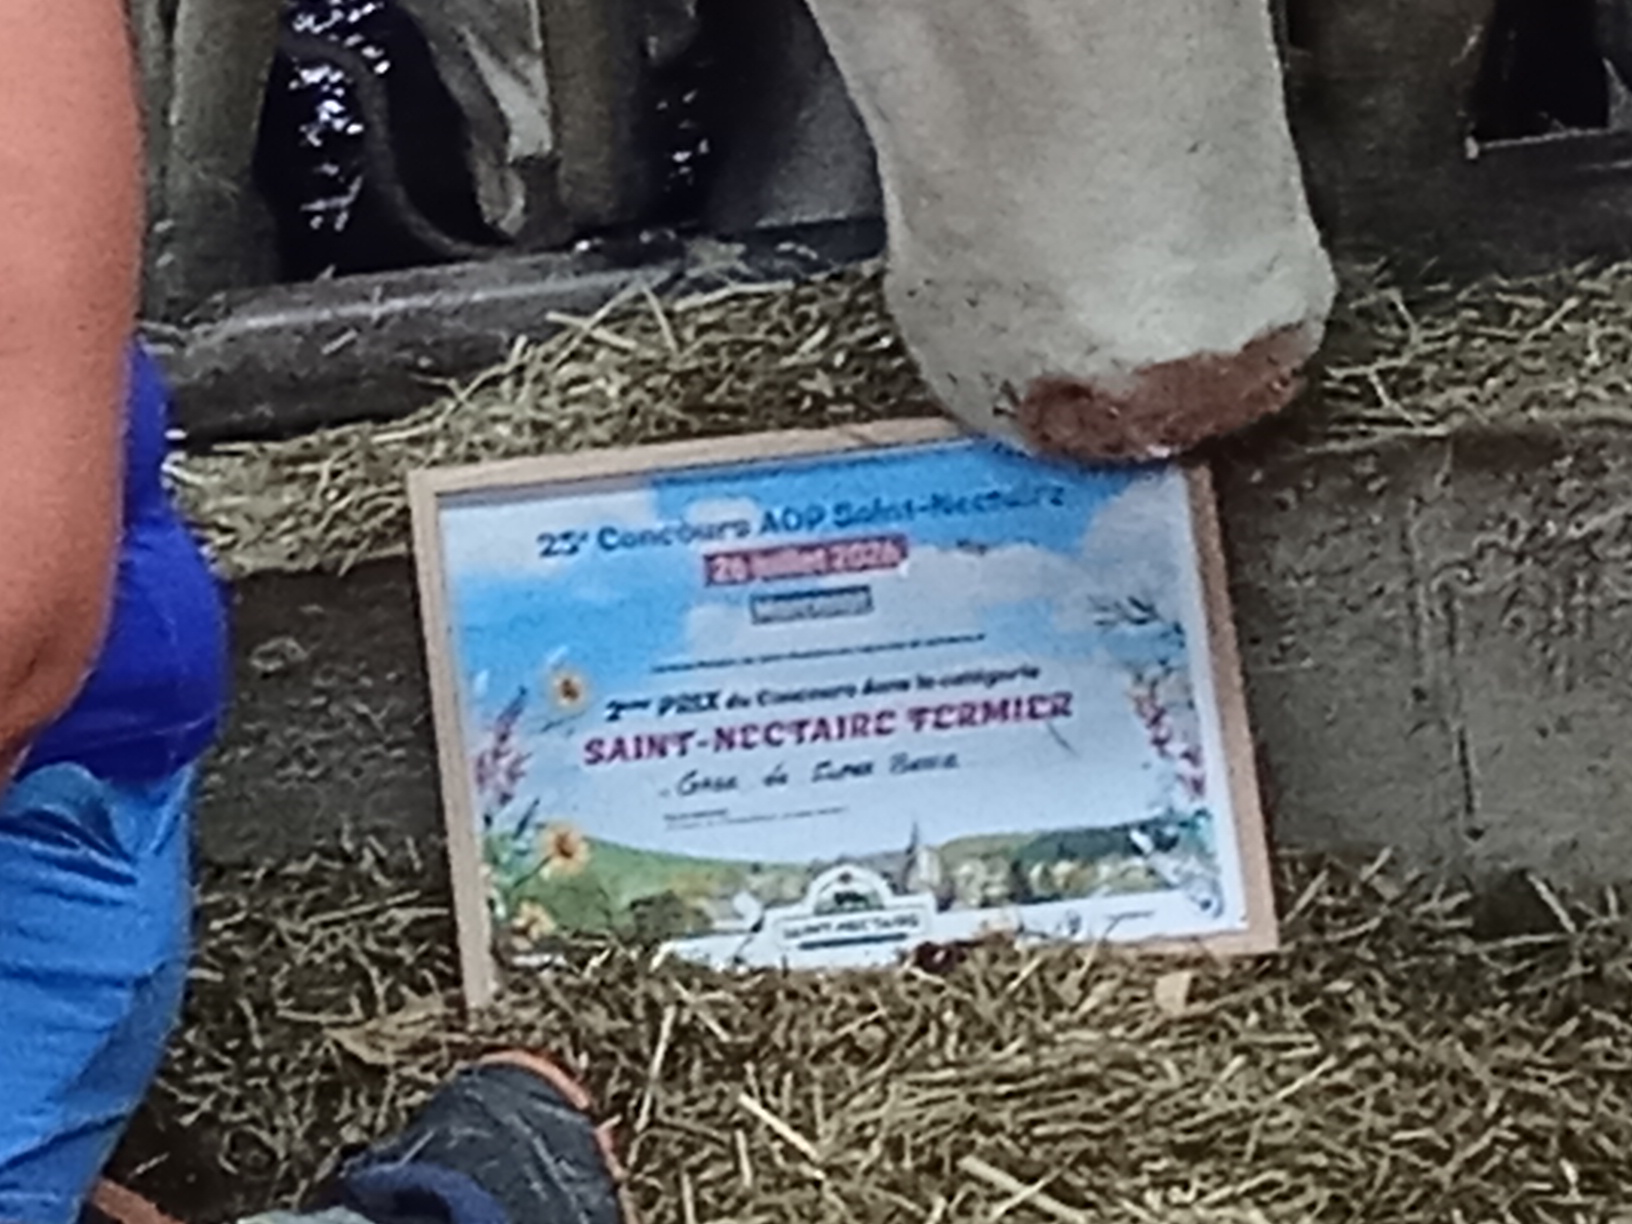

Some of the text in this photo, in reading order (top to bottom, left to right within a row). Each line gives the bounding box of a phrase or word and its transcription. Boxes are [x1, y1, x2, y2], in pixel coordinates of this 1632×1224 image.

[597, 520, 750, 551] Concours
[760, 505, 825, 534] AOP
[658, 690, 721, 717] PRIX
[583, 690, 1074, 766] SAINT-NECTAIRE FERMIER
